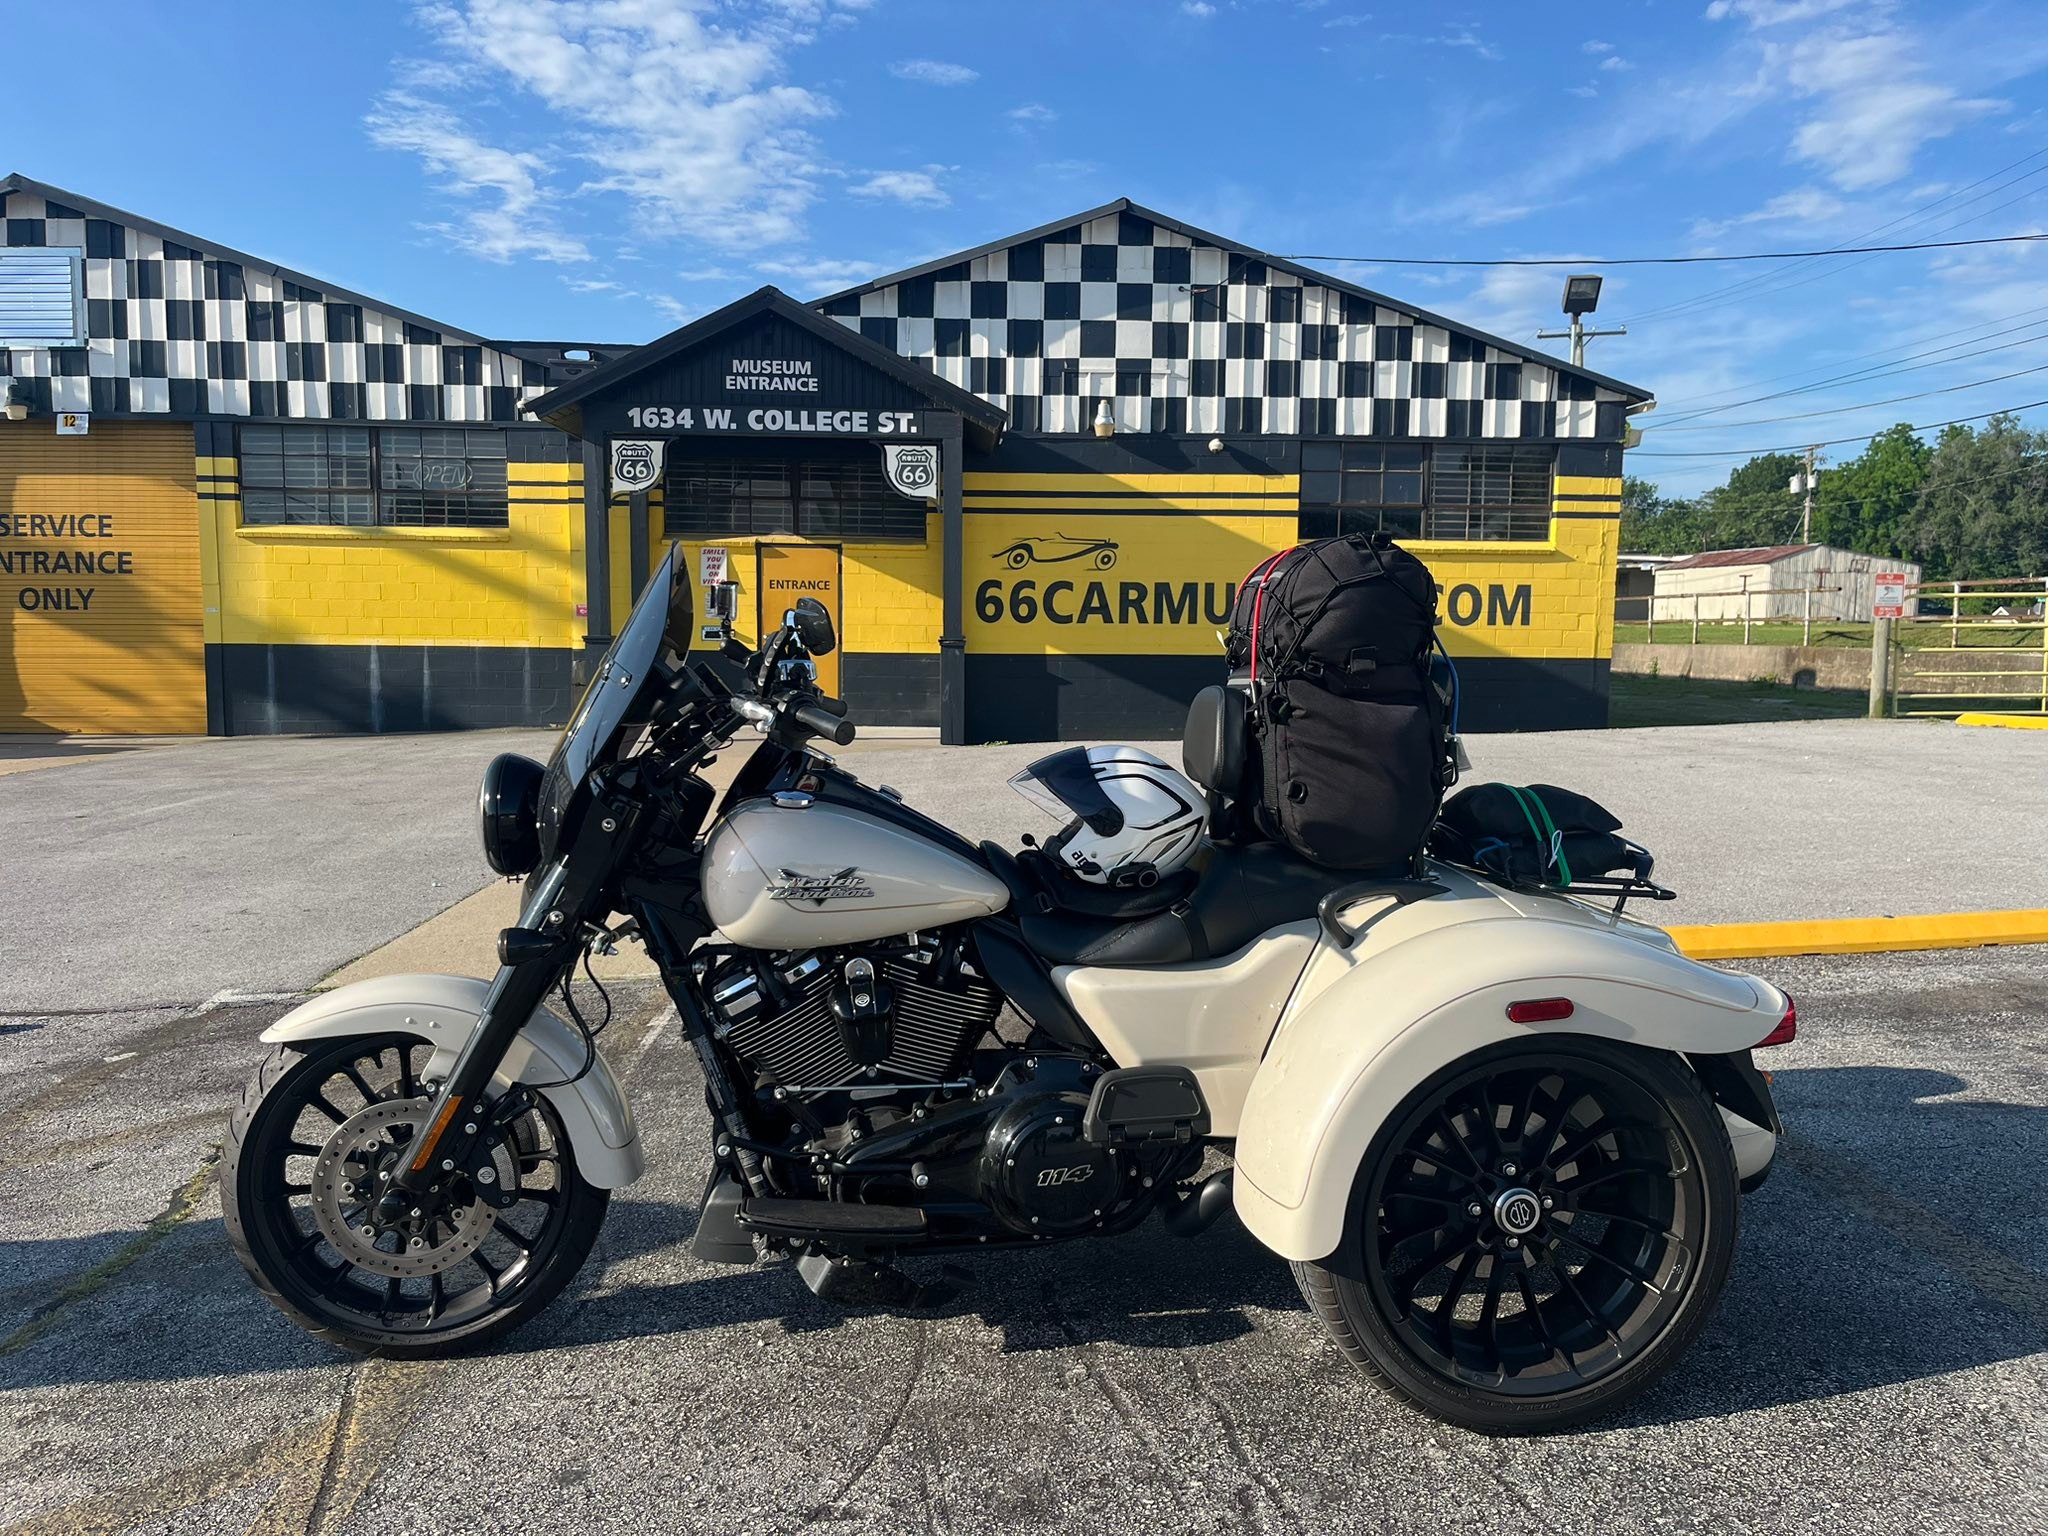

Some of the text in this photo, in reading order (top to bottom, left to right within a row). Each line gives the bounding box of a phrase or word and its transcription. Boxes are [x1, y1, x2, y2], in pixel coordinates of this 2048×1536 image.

[732, 359, 812, 375] MUSEUM
[725, 375, 818, 391] ENTRANCE
[63, 415, 76, 427] 12
[627, 407, 918, 433] 1634 W. COLLEGE ST.
[416, 464, 466, 484] OPEN
[622, 460, 648, 478] 66
[902, 466, 927, 483] 66
[0, 513, 113, 537] SERVICE
[0, 550, 133, 574] NTRANCE
[769, 579, 831, 591] ENTRANCE
[19, 587, 95, 611] ONLY
[1036, 1164, 1094, 1187] 114
